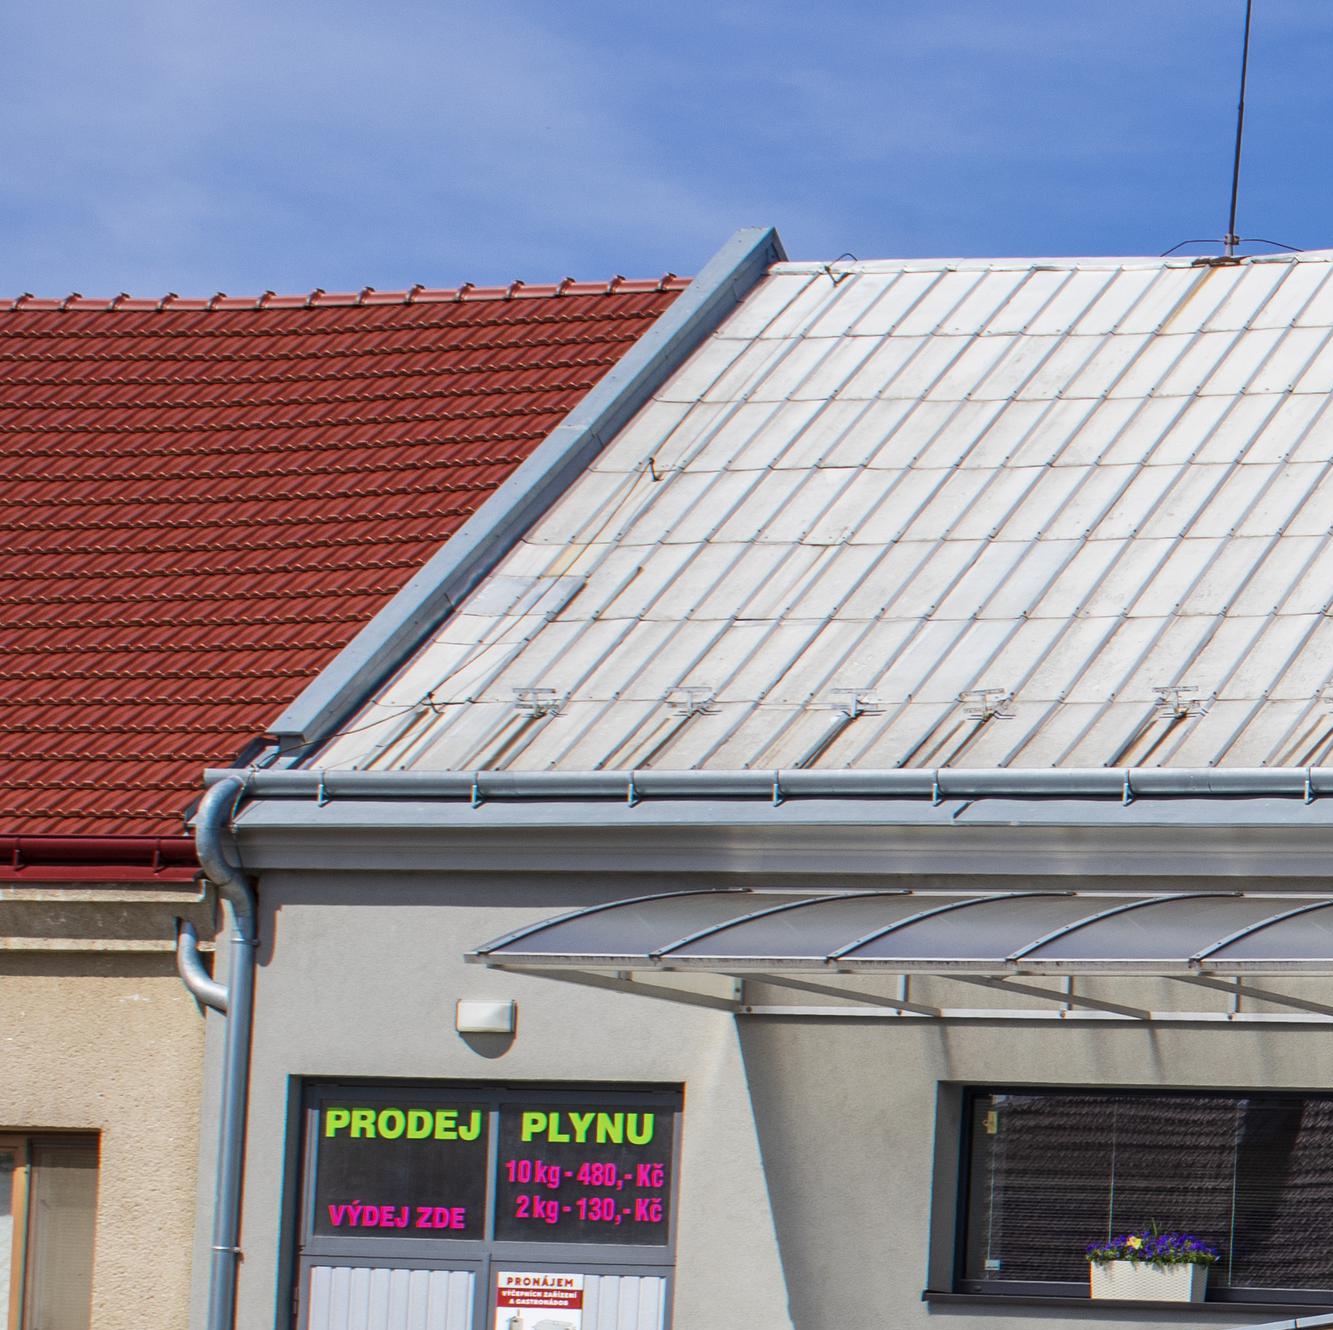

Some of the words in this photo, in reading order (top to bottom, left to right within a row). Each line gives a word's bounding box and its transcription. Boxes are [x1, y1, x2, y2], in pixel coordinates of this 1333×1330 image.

[325, 1107, 482, 1141] PRODEJ
[521, 1111, 656, 1146] PLYNU
[328, 1200, 410, 1228] VÝDEJ
[415, 1206, 466, 1229] ZDE
[506, 1275, 574, 1287] PRONÁJEM
